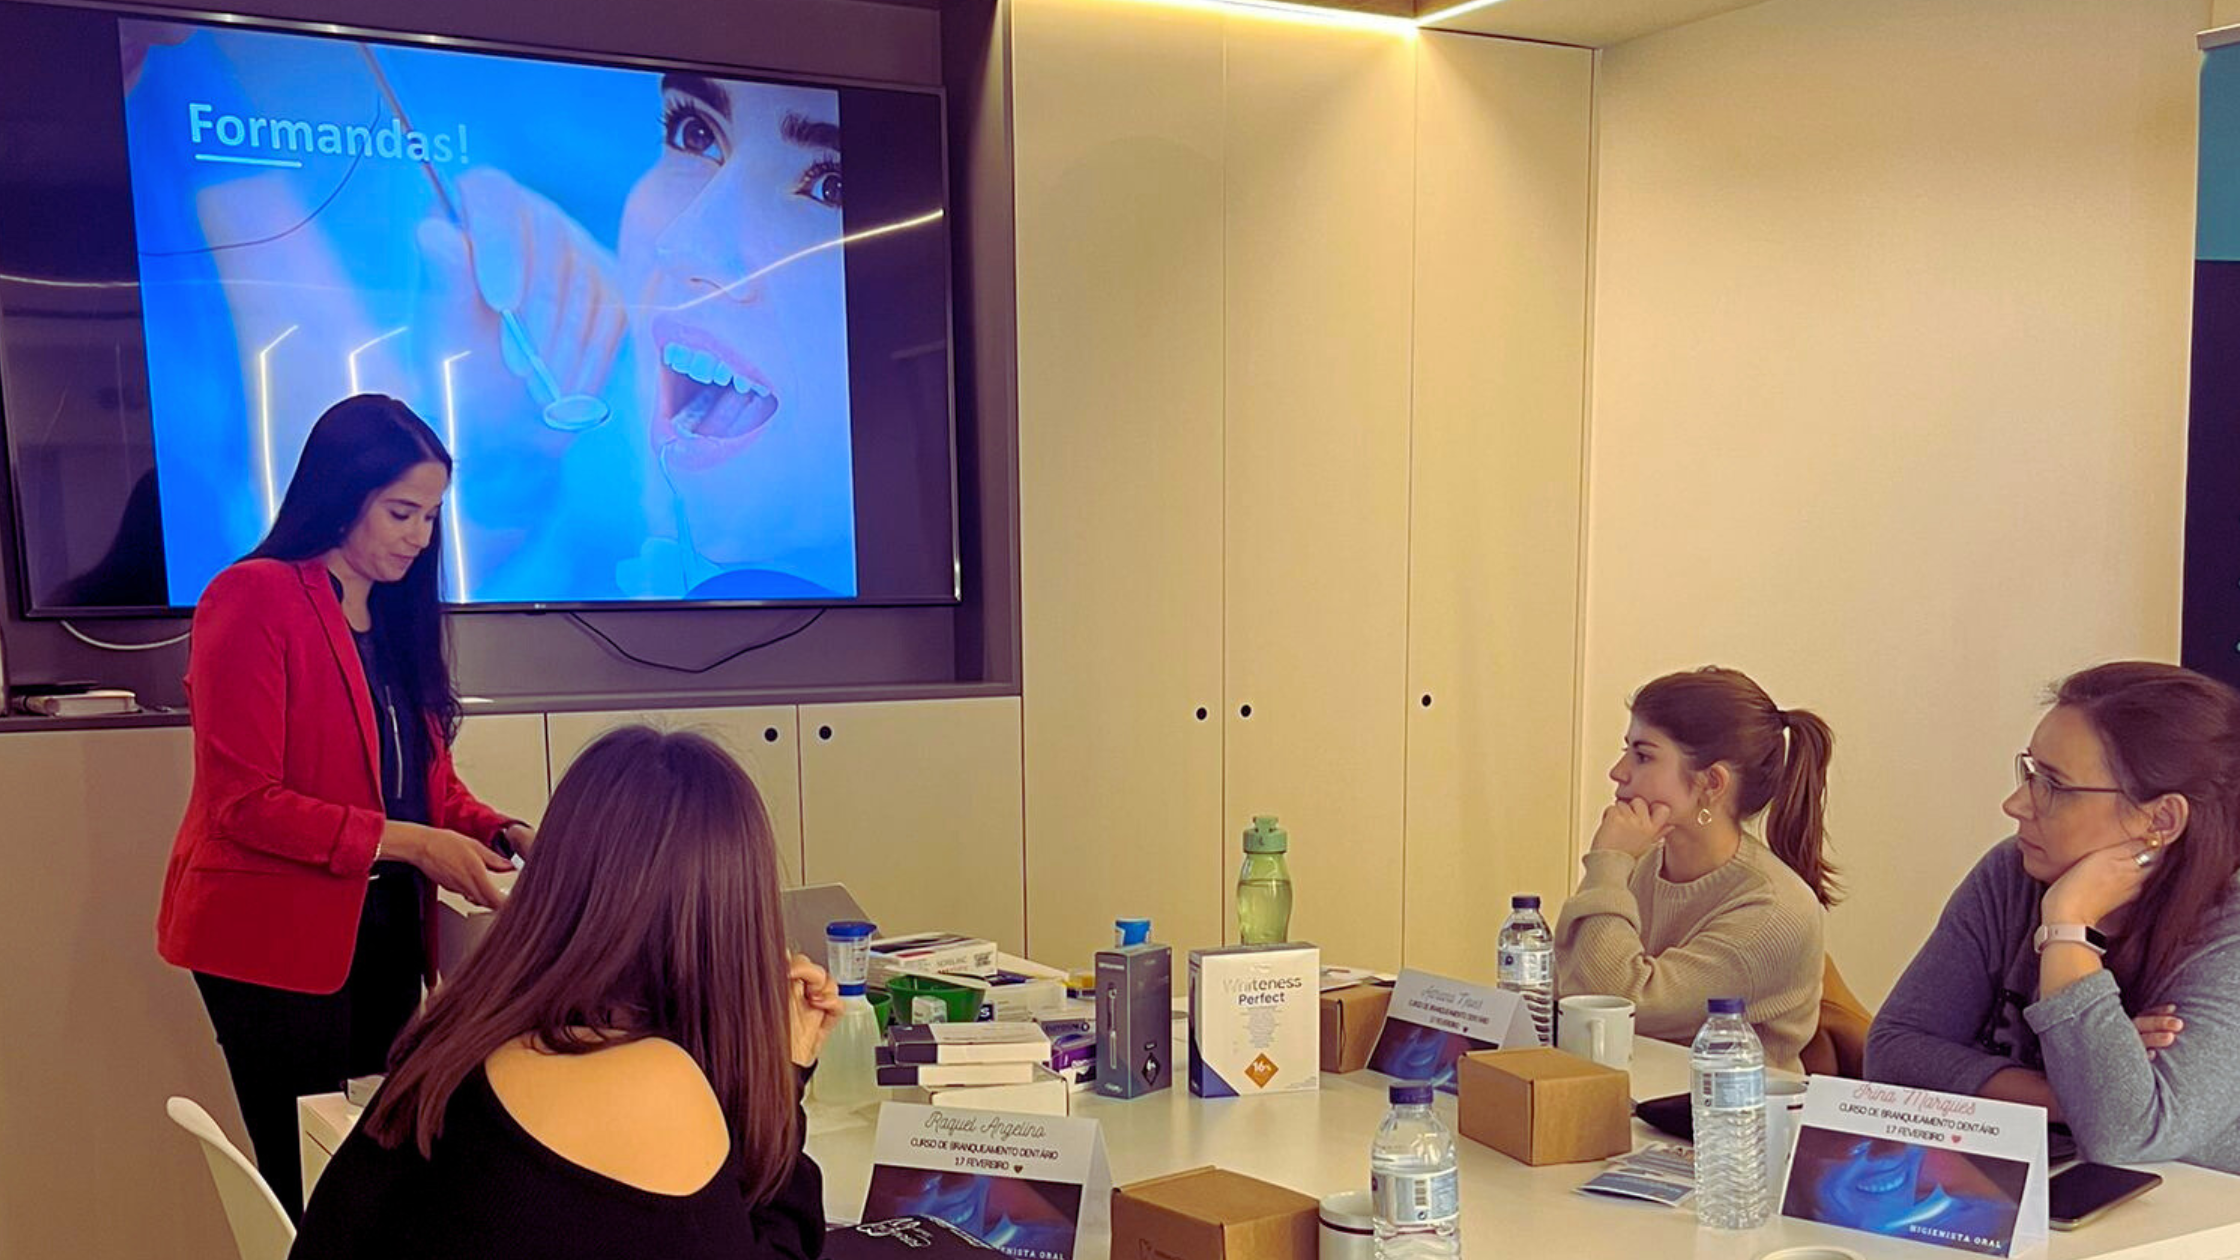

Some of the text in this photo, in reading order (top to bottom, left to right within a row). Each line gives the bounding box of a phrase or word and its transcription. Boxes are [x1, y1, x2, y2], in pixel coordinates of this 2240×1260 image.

[188, 102, 469, 164] Formandas!
[1223, 977, 1302, 993] Whiteness
[1239, 992, 1285, 1004] Perfect
[1903, 1089, 1976, 1117] Marques
[1838, 1102, 1867, 1115] CURSO
[1868, 1107, 1880, 1117] DE
[1881, 1109, 1955, 1129] BRANQUEAMENTO
[924, 1110, 1047, 1141] Raquel Angelino
[1886, 1124, 1945, 1142] 17 FEVEREIRO
[910, 1137, 937, 1149] CURSO
[938, 1139, 948, 1150] DE
[949, 1140, 1018, 1157] BRANQUEAMENTO
[955, 1155, 1009, 1170] 17 FEVEREIRO
[1973, 1236, 2002, 1249] ORAL
